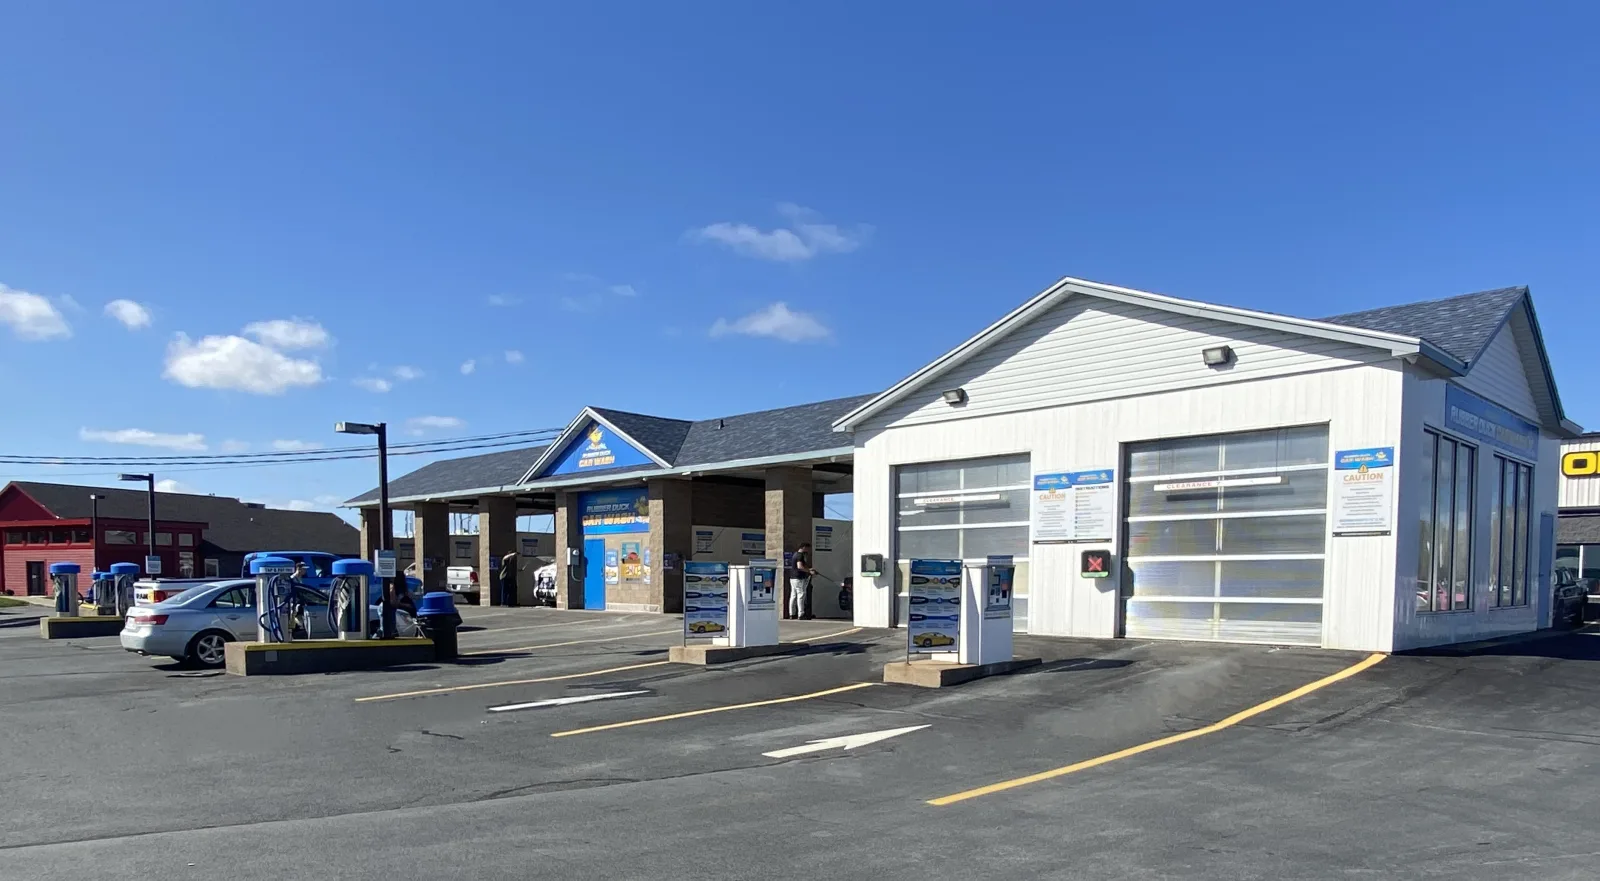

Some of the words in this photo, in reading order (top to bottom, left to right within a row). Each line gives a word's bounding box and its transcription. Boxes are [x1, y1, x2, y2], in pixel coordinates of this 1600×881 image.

[1562, 451, 1600, 476] O
[1343, 472, 1384, 482] CAUTION
[612, 503, 630, 511] DUCK
[582, 515, 602, 526] CAR
[604, 512, 636, 525] WASH
